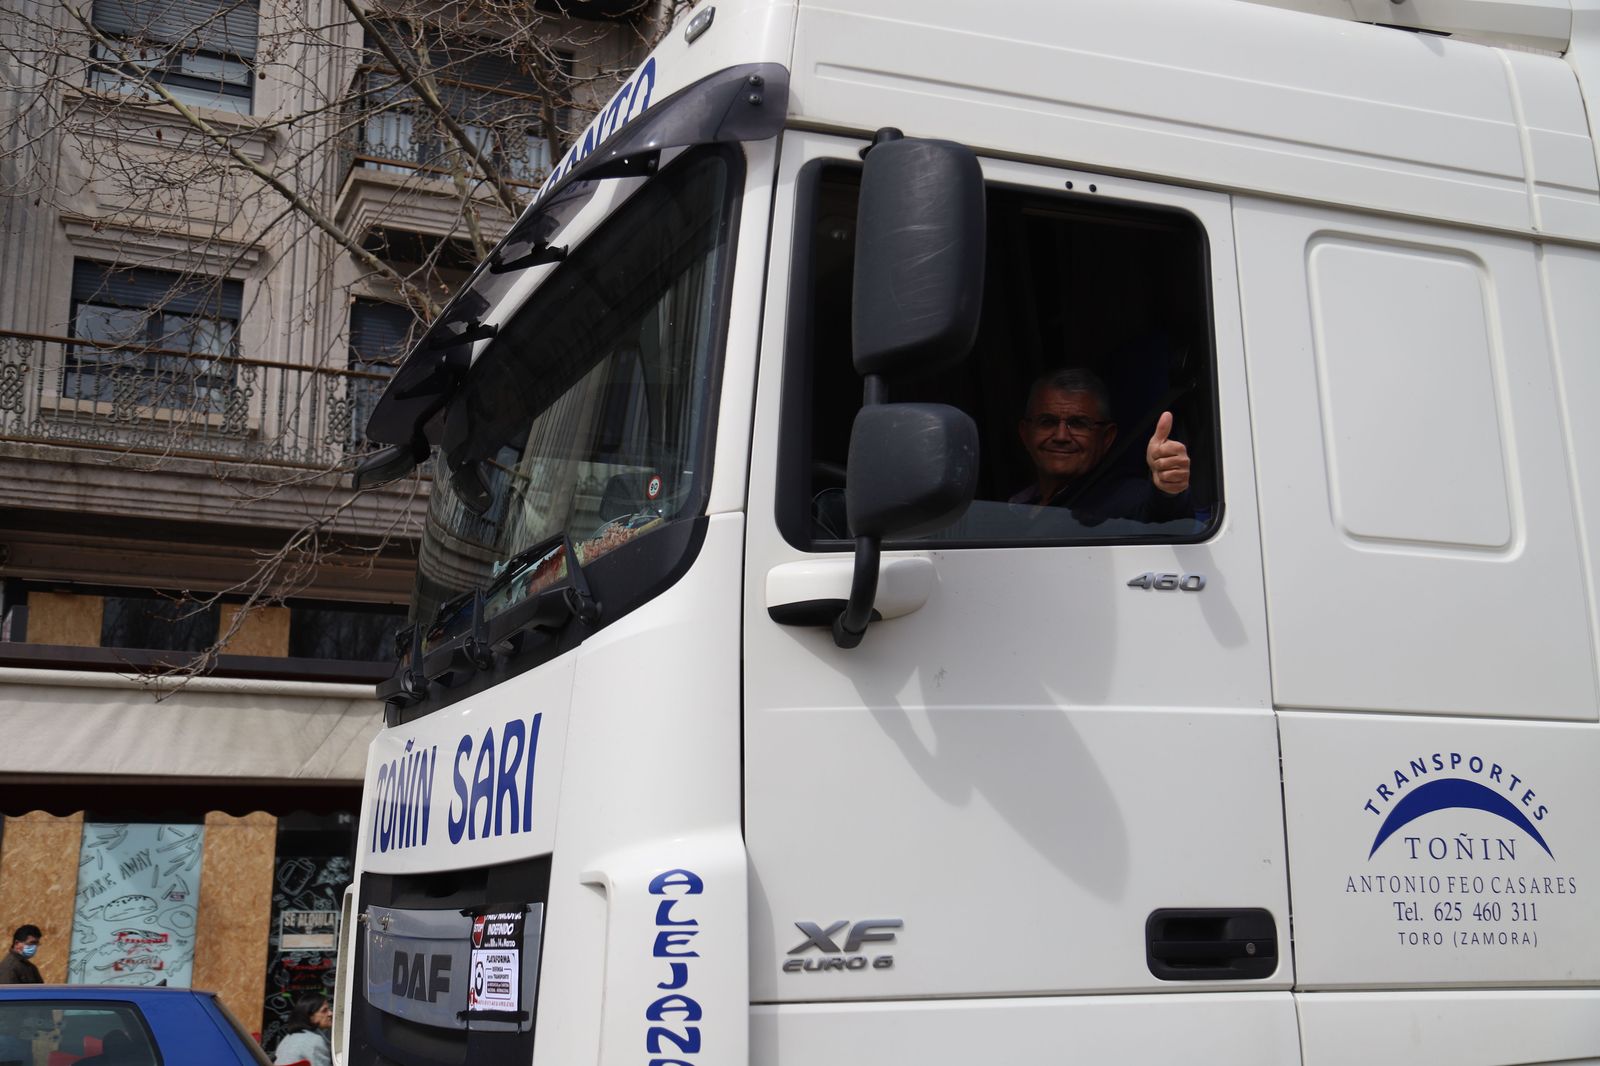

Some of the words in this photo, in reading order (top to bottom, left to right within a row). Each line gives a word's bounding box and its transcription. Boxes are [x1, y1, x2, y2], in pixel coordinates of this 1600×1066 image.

[1126, 572, 1206, 591] 460
[372, 737, 437, 853] TOÑIN
[448, 712, 542, 845] SARI
[1364, 752, 1548, 821] TRANSPORTES
[1404, 833, 1516, 861] TOÑIN
[119, 848, 152, 880] AWAY
[1345, 875, 1440, 894] ANTONIO
[1447, 876, 1484, 894] FEO
[1491, 876, 1577, 894] CASARES
[284, 911, 296, 927] SE
[297, 911, 335, 928] ALQUILA
[1393, 901, 1423, 921] Tel.
[1434, 902, 1463, 922] 625
[1472, 902, 1502, 922] 460
[1511, 902, 1538, 922] 311
[786, 918, 904, 955] XF
[1398, 932, 1444, 945] TORO
[1453, 931, 1538, 948] (ZAMORA)
[391, 950, 453, 1003] DAF
[646, 868, 704, 1066] ALEJAN
[782, 956, 868, 972] EURO
[872, 955, 894, 969] 6
